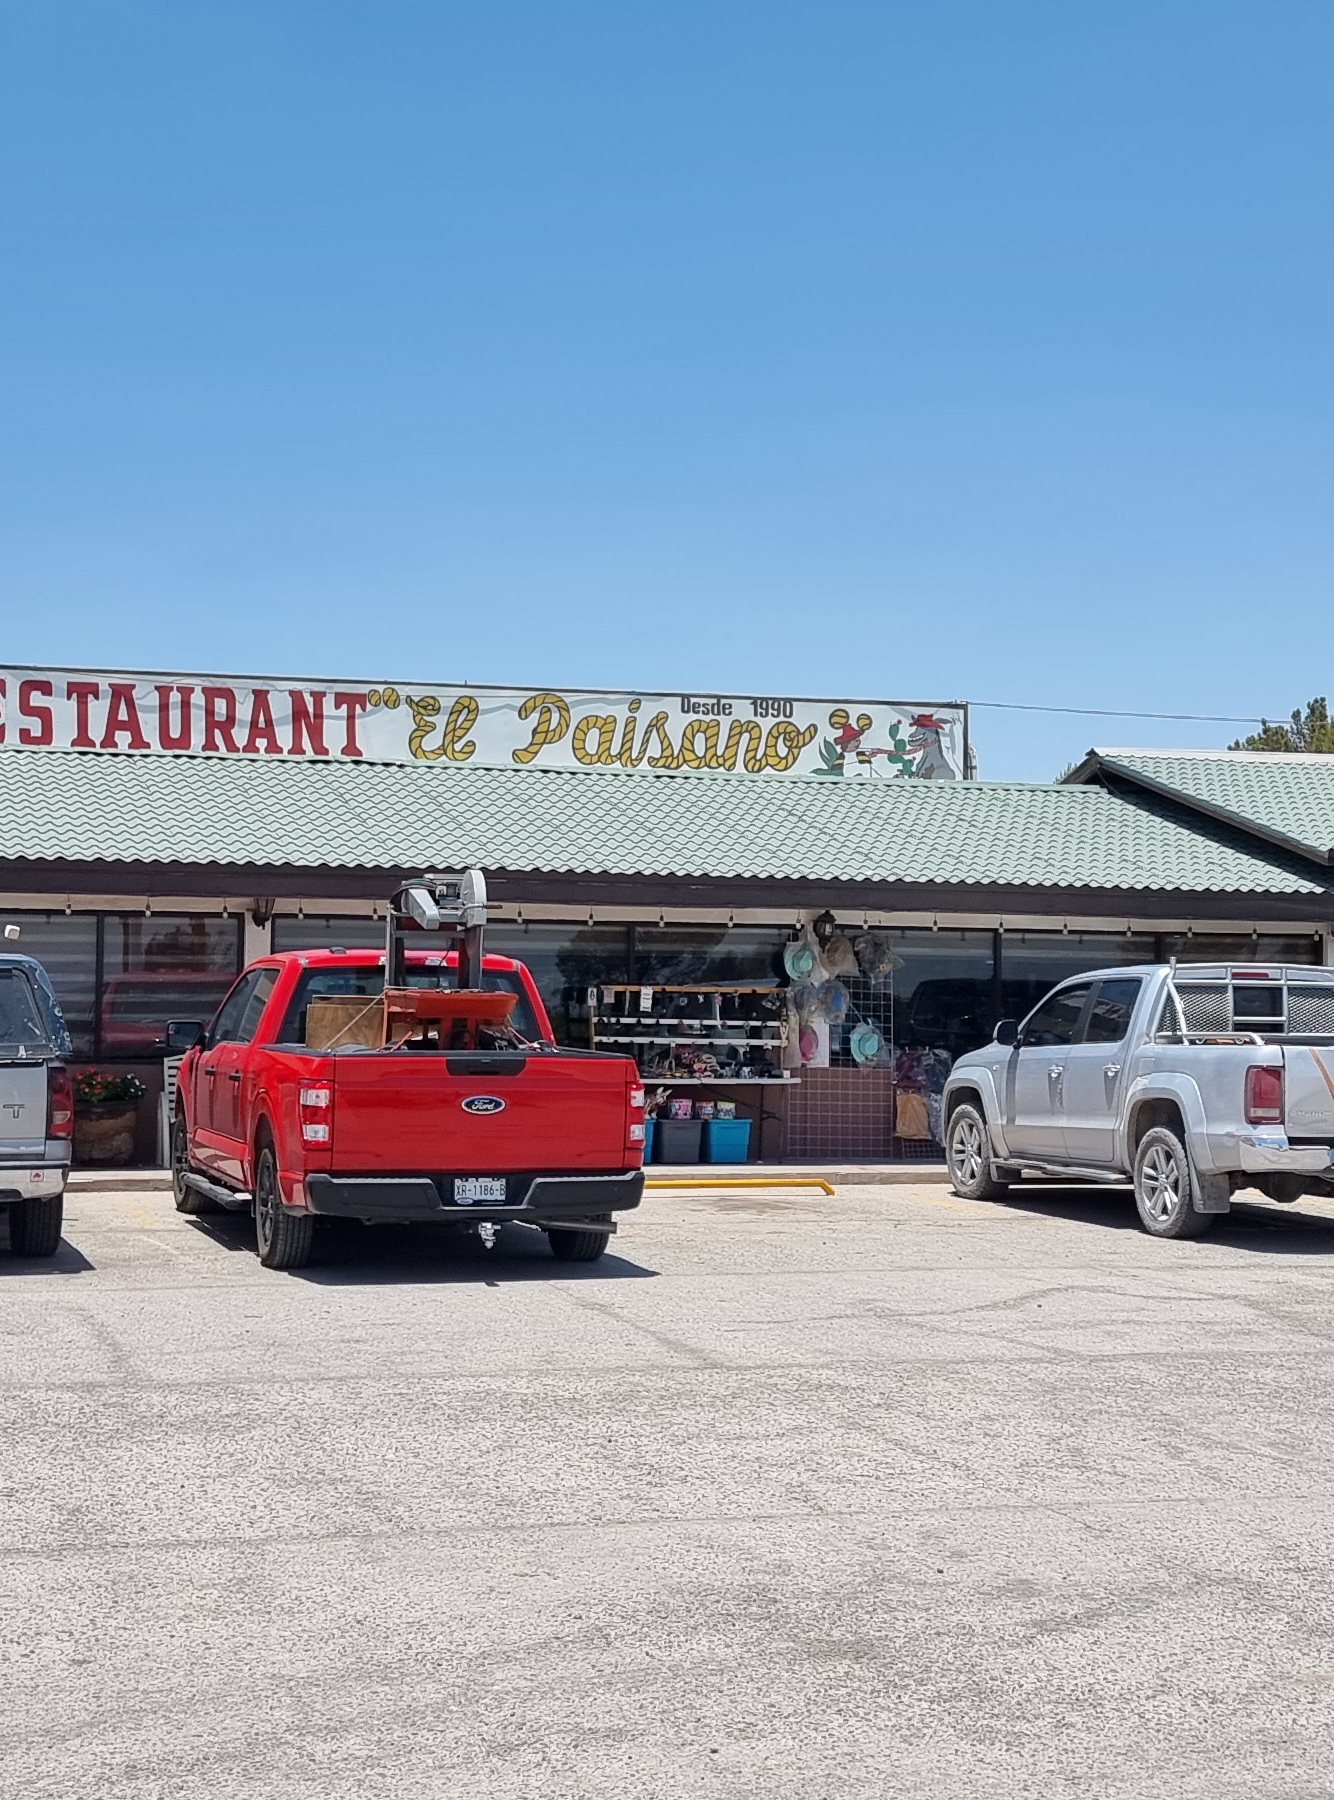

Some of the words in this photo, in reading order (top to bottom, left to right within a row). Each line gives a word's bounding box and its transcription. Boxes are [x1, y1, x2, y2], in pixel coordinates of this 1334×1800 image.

[680, 696, 734, 717] Desde
[748, 698, 795, 719] 1990
[472, 1099, 496, 1110] Ford
